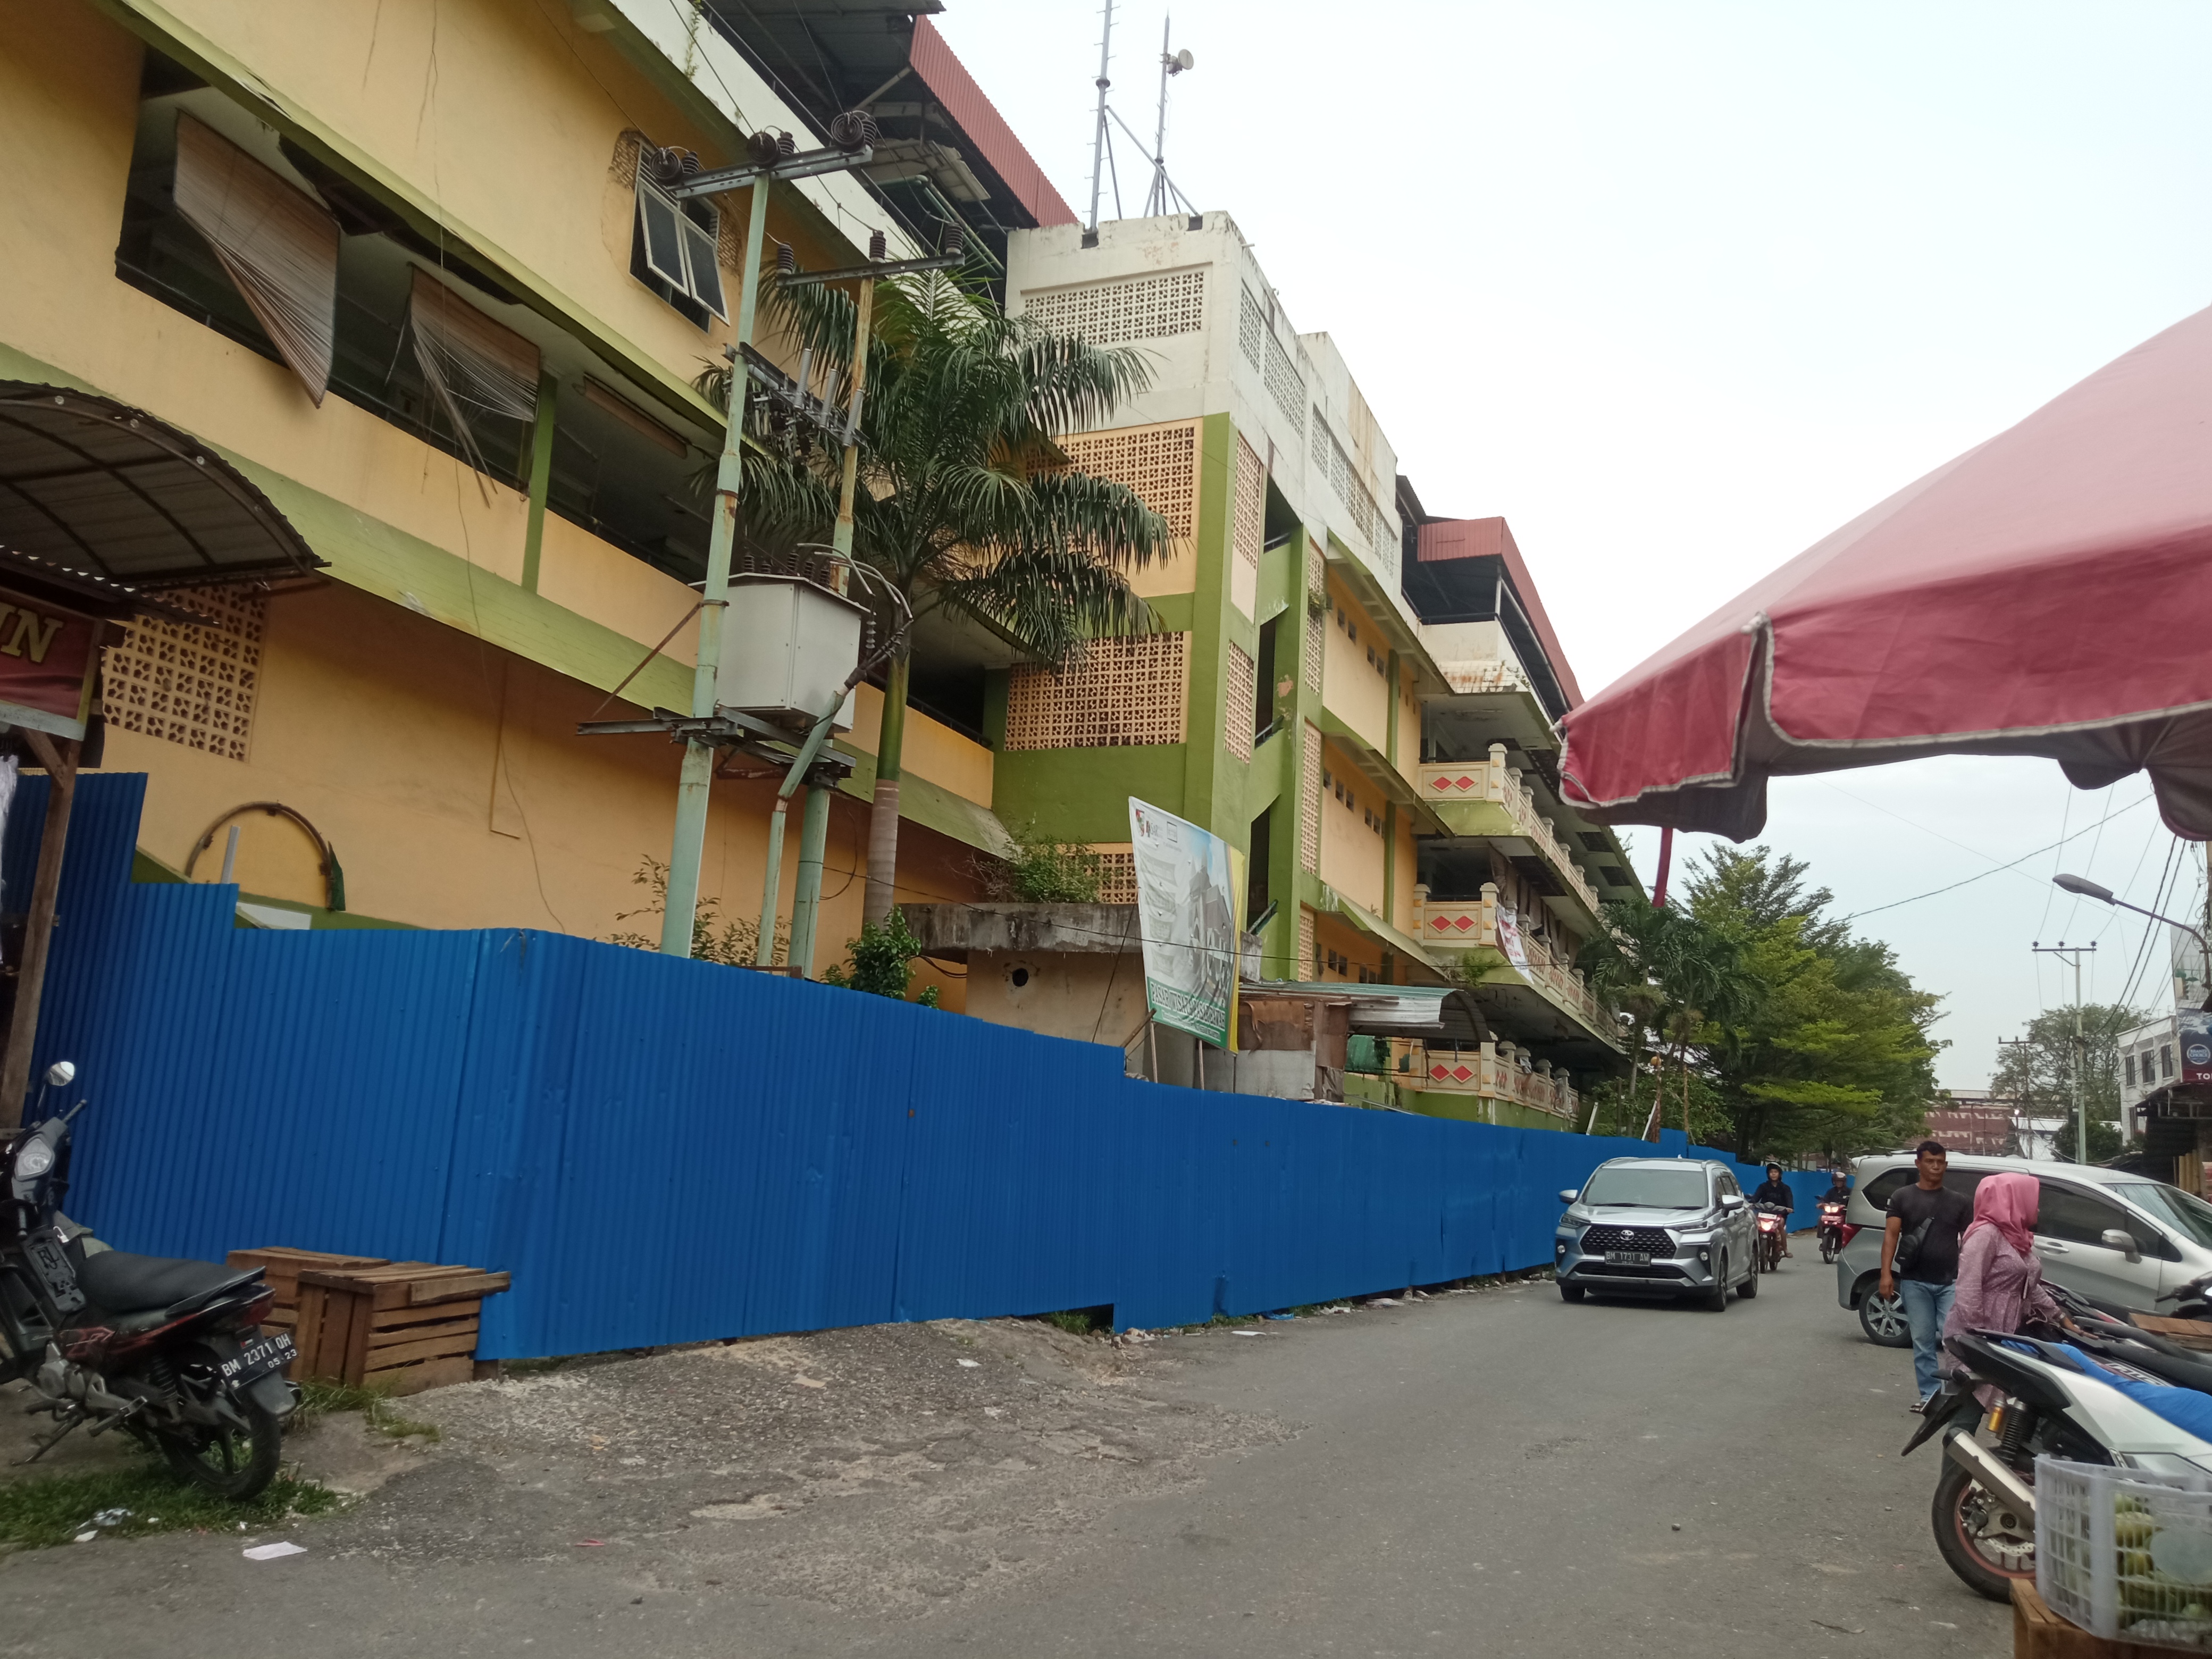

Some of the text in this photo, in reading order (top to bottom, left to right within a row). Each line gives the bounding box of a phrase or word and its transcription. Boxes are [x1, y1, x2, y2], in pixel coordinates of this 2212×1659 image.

[1151, 982, 1170, 1009] PASAR
[1620, 1252, 1635, 1261] 1731
[221, 1333, 291, 1377] BM 2371 QH
